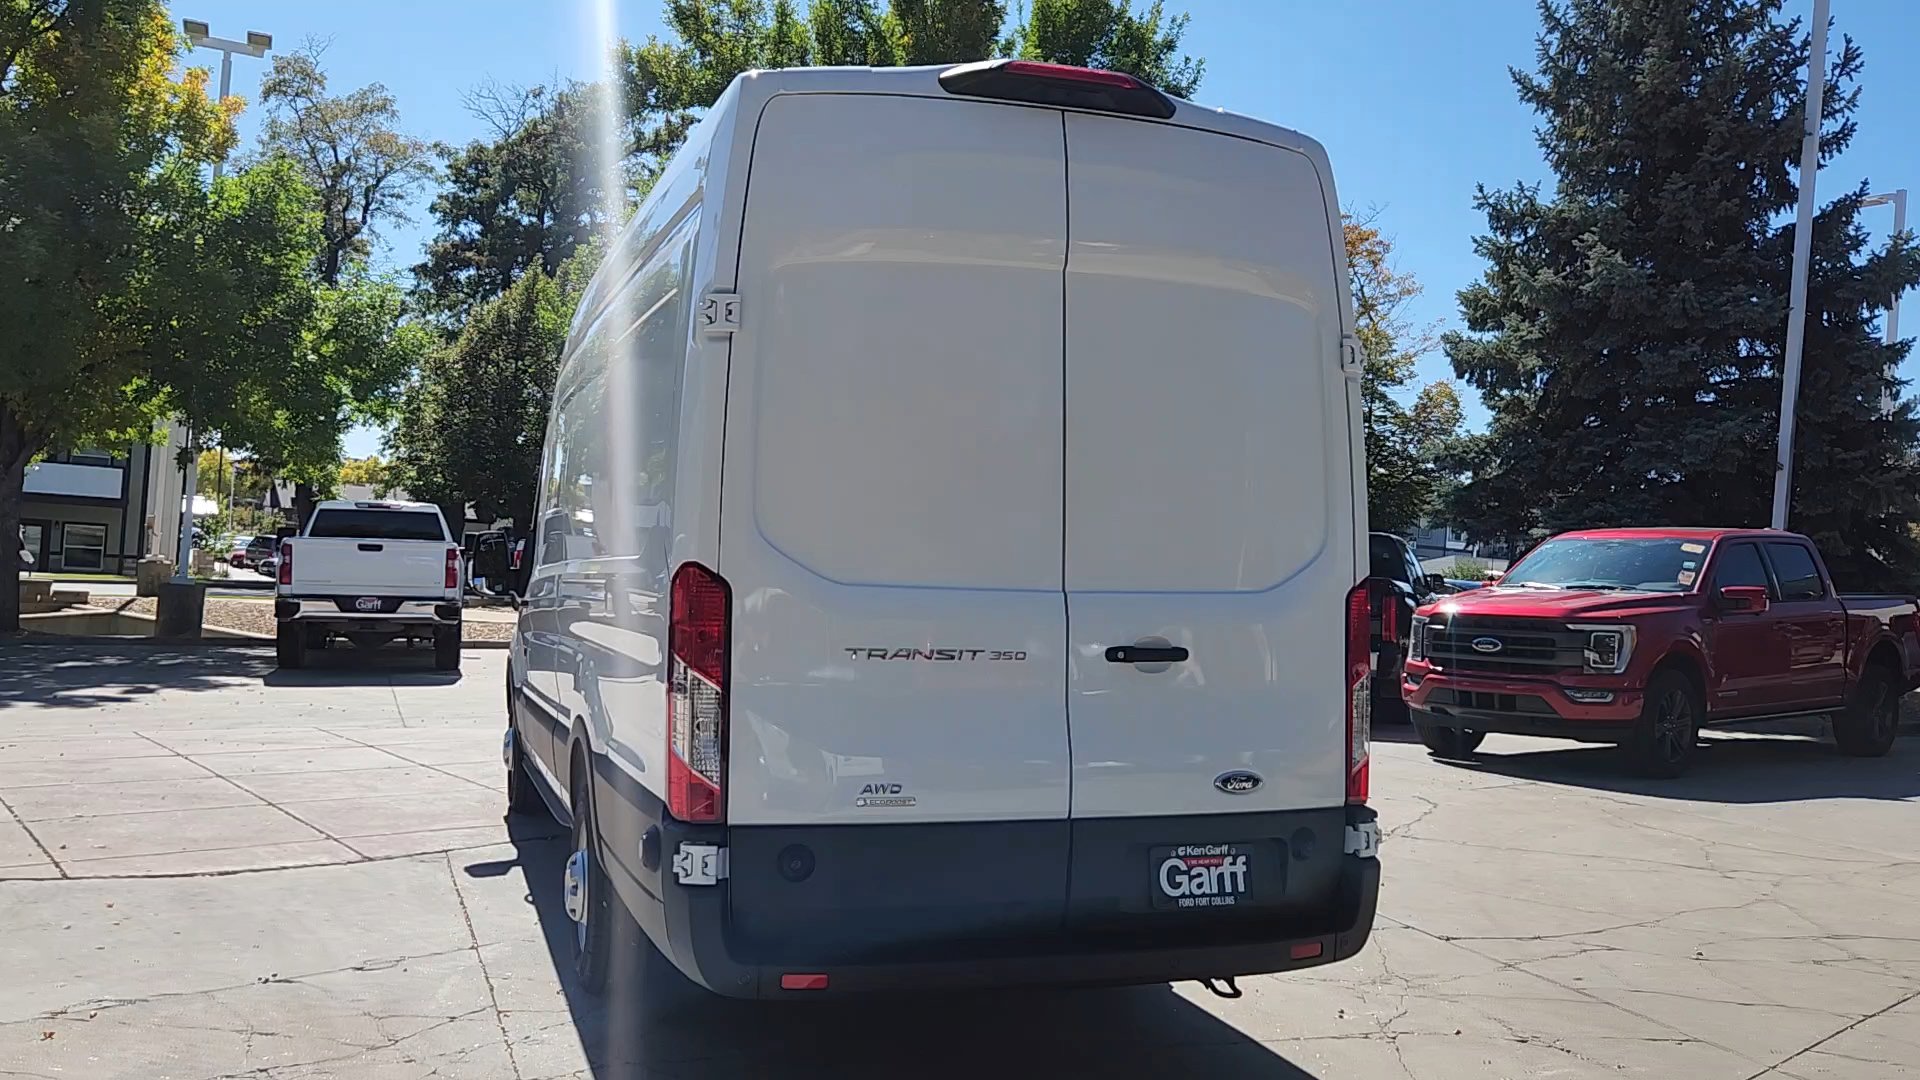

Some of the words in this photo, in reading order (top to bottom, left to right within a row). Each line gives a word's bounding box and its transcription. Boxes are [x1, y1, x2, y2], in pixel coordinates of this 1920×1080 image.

[844, 648, 986, 661] TRANSIT
[988, 651, 1027, 661] 350
[1227, 776, 1253, 789] Ford
[859, 783, 902, 795] AWD
[1186, 846, 1205, 855] Ken
[1205, 845, 1228, 855] Garff
[1160, 855, 1247, 897] Garff
[1178, 898, 1194, 907] FORD
[1195, 897, 1210, 906] FORT
[1211, 896, 1235, 905] COLLINS
